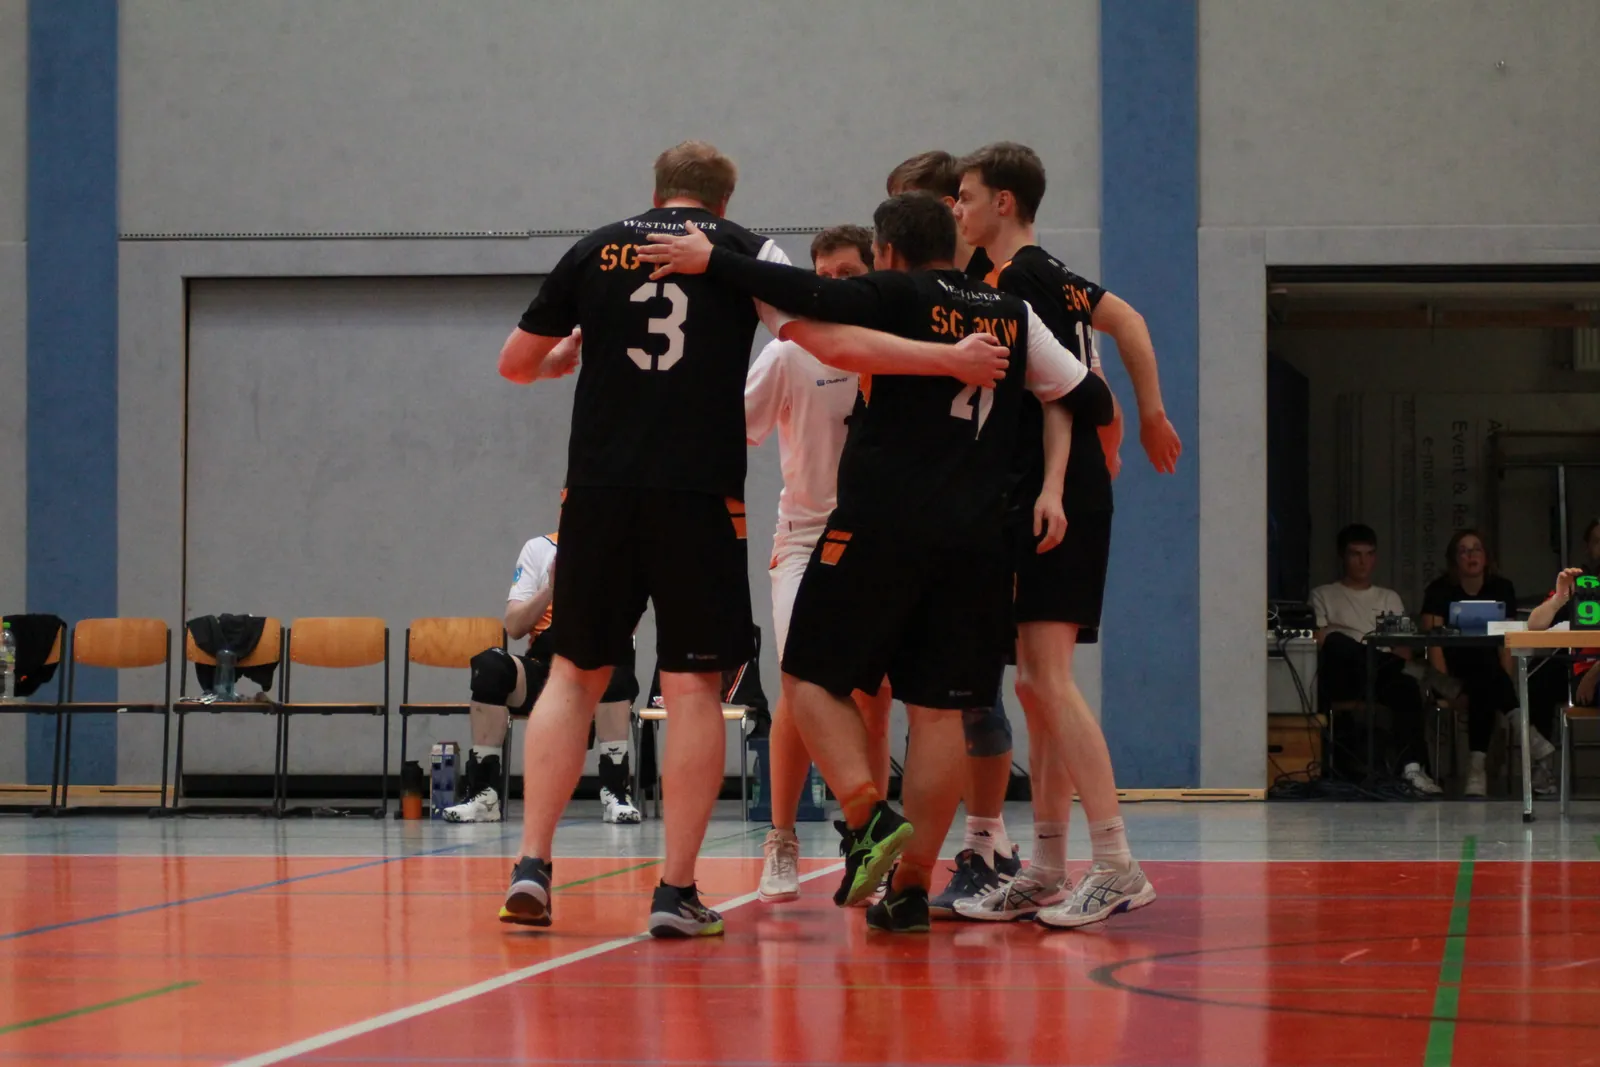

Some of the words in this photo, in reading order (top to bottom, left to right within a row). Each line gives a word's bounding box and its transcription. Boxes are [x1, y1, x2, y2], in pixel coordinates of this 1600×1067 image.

[623, 220, 717, 230] WESTMINTER
[600, 243, 640, 271] SG
[627, 281, 689, 371] 3
[1452, 420, 1469, 477] Event
[1577, 600, 1600, 625] 9
